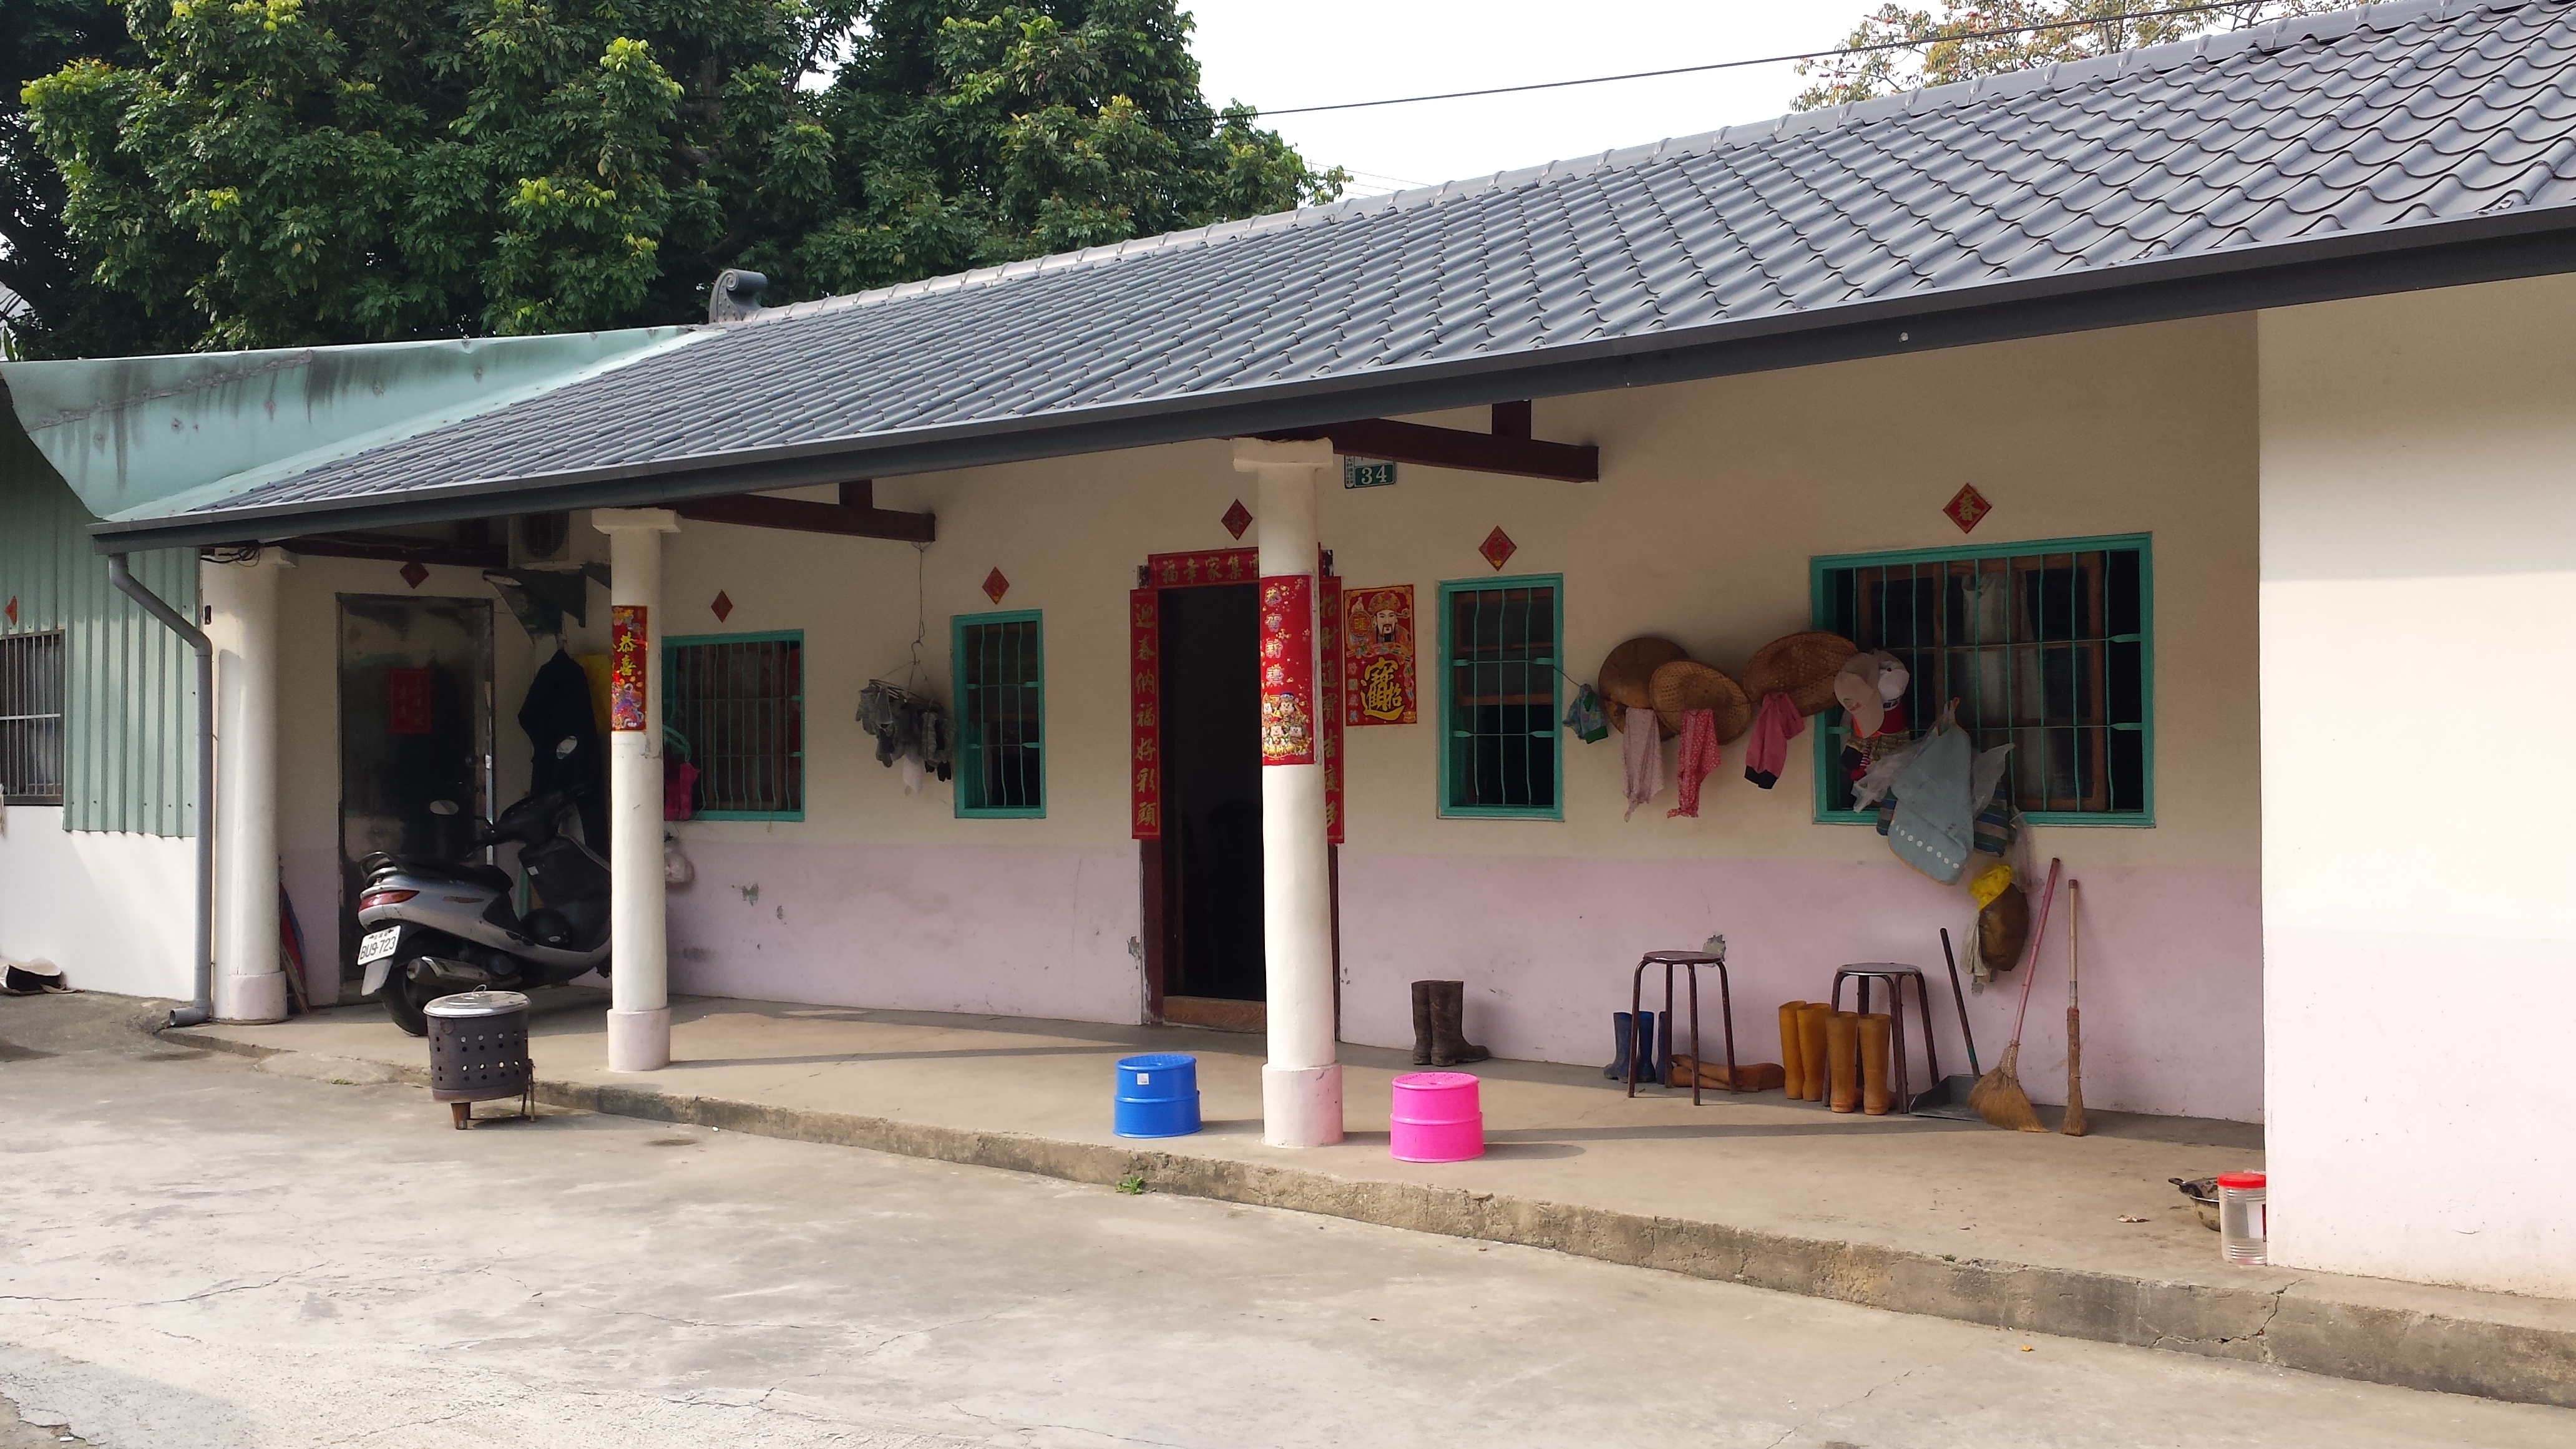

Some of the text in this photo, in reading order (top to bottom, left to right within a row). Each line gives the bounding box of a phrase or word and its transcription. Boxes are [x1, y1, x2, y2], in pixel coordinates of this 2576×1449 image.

[1362, 466, 1387, 484] 34
[1958, 492, 1981, 521] 春
[617, 630, 638, 676] 恭喜
[1265, 587, 1284, 686] 恭賀新禧
[1134, 602, 1156, 827] 迎春納福好彩頭
[359, 936, 396, 960] BU9-723
